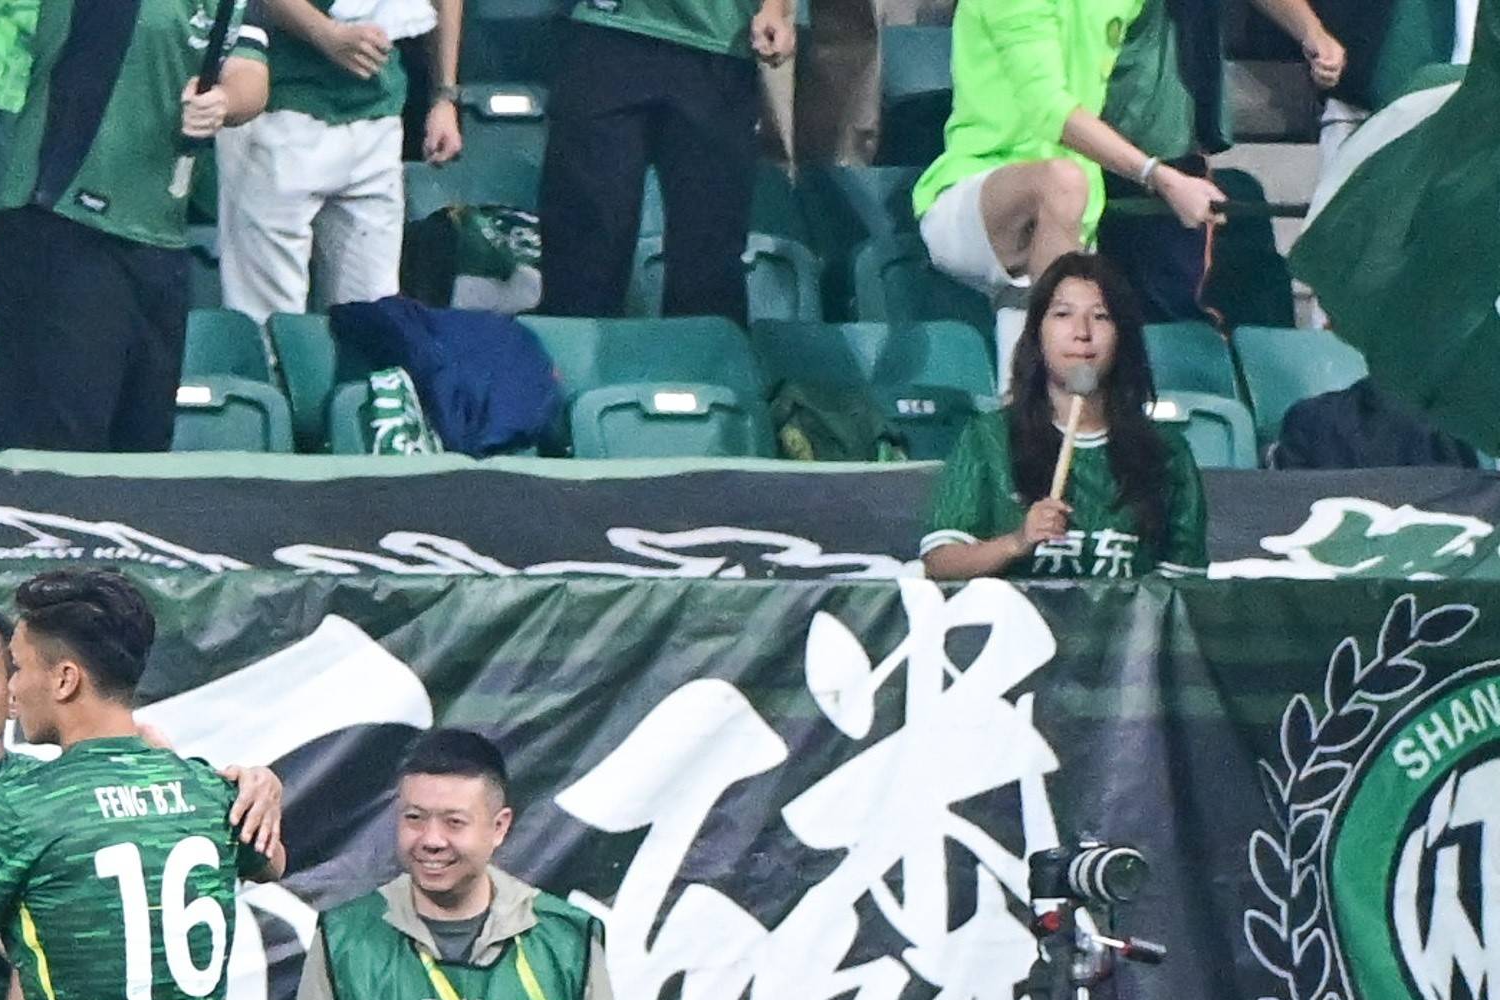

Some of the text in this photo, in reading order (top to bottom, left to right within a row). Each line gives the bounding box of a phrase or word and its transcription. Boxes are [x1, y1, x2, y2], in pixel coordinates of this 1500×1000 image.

[1032, 528, 1140, 578] 京东
[94, 781, 197, 819] FENG B.X.
